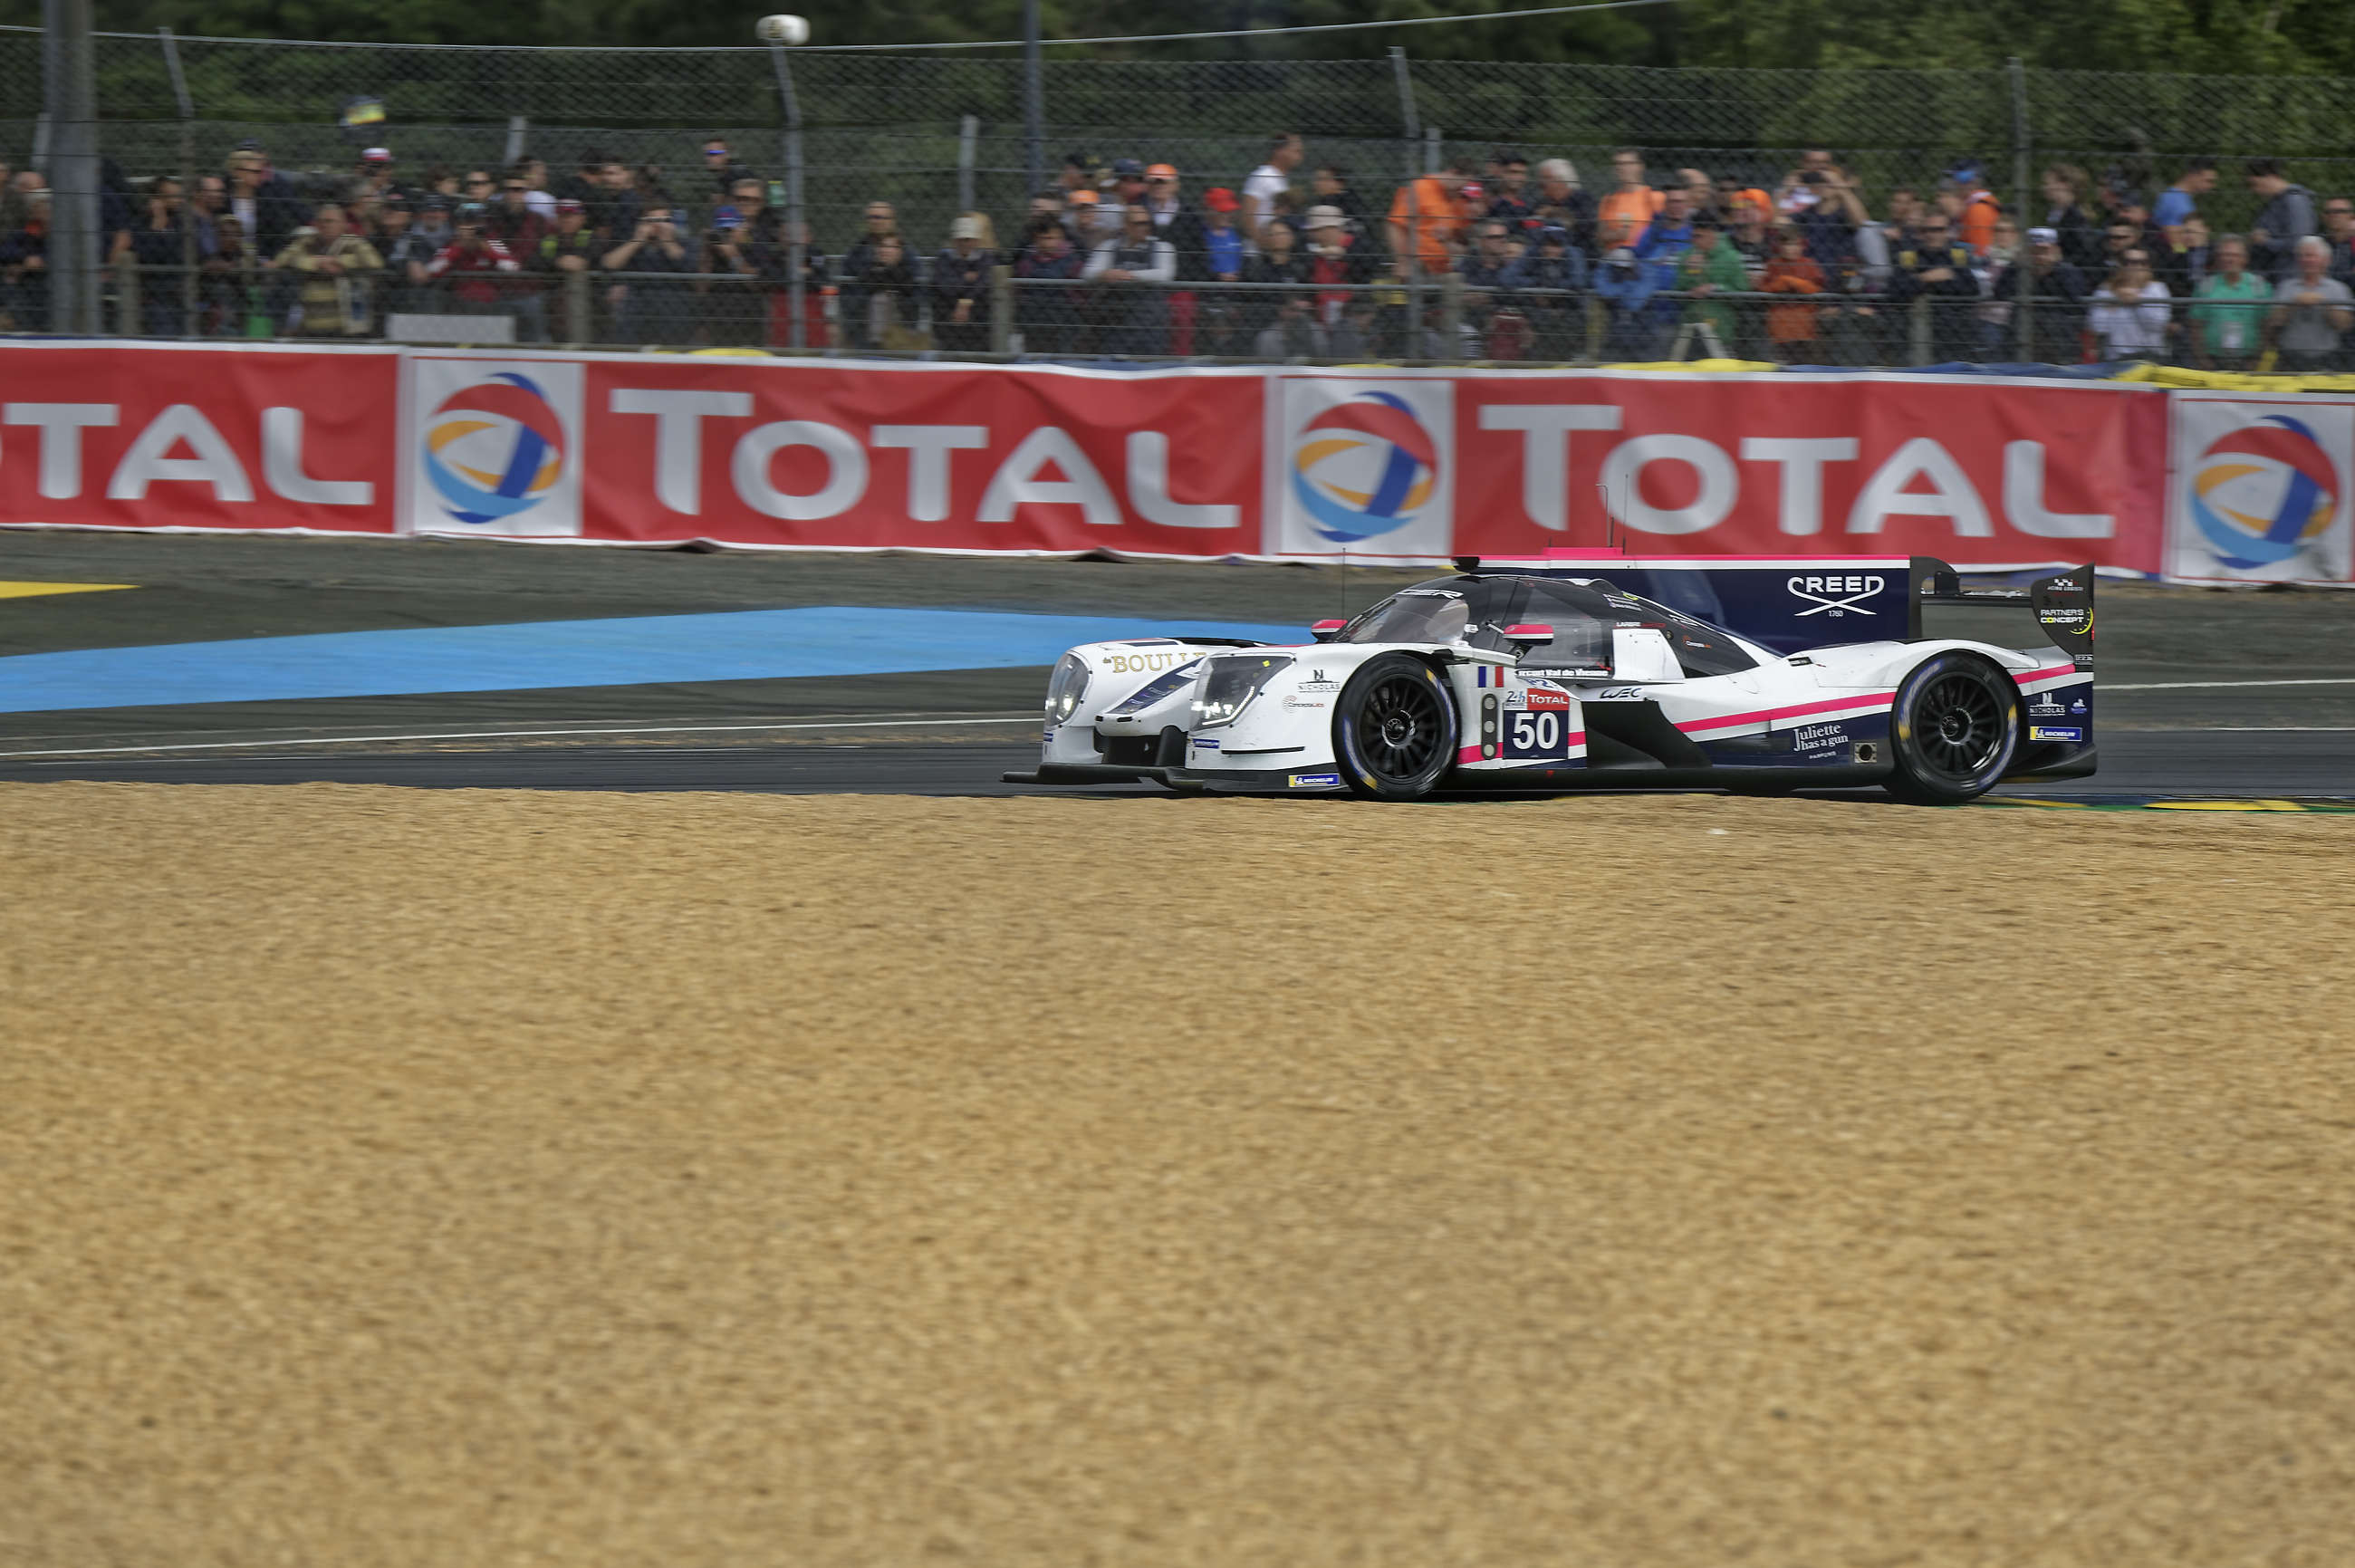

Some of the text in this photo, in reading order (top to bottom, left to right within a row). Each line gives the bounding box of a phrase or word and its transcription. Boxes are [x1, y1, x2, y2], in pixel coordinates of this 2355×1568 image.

[0, 402, 374, 505] TAL
[610, 388, 1241, 529] TOTAL
[1479, 403, 2115, 539] TOTAL
[1787, 575, 1885, 598] CREED
[2040, 616, 2084, 624] CONCEPT
[1111, 652, 1207, 673] BOUL
[1528, 693, 1569, 705] TOTAL
[1600, 687, 1642, 699] WEC
[1512, 711, 1559, 750] 50
[1793, 724, 1841, 752] Juliette
[1800, 739, 1820, 751] has
[1828, 735, 1849, 747] gun
